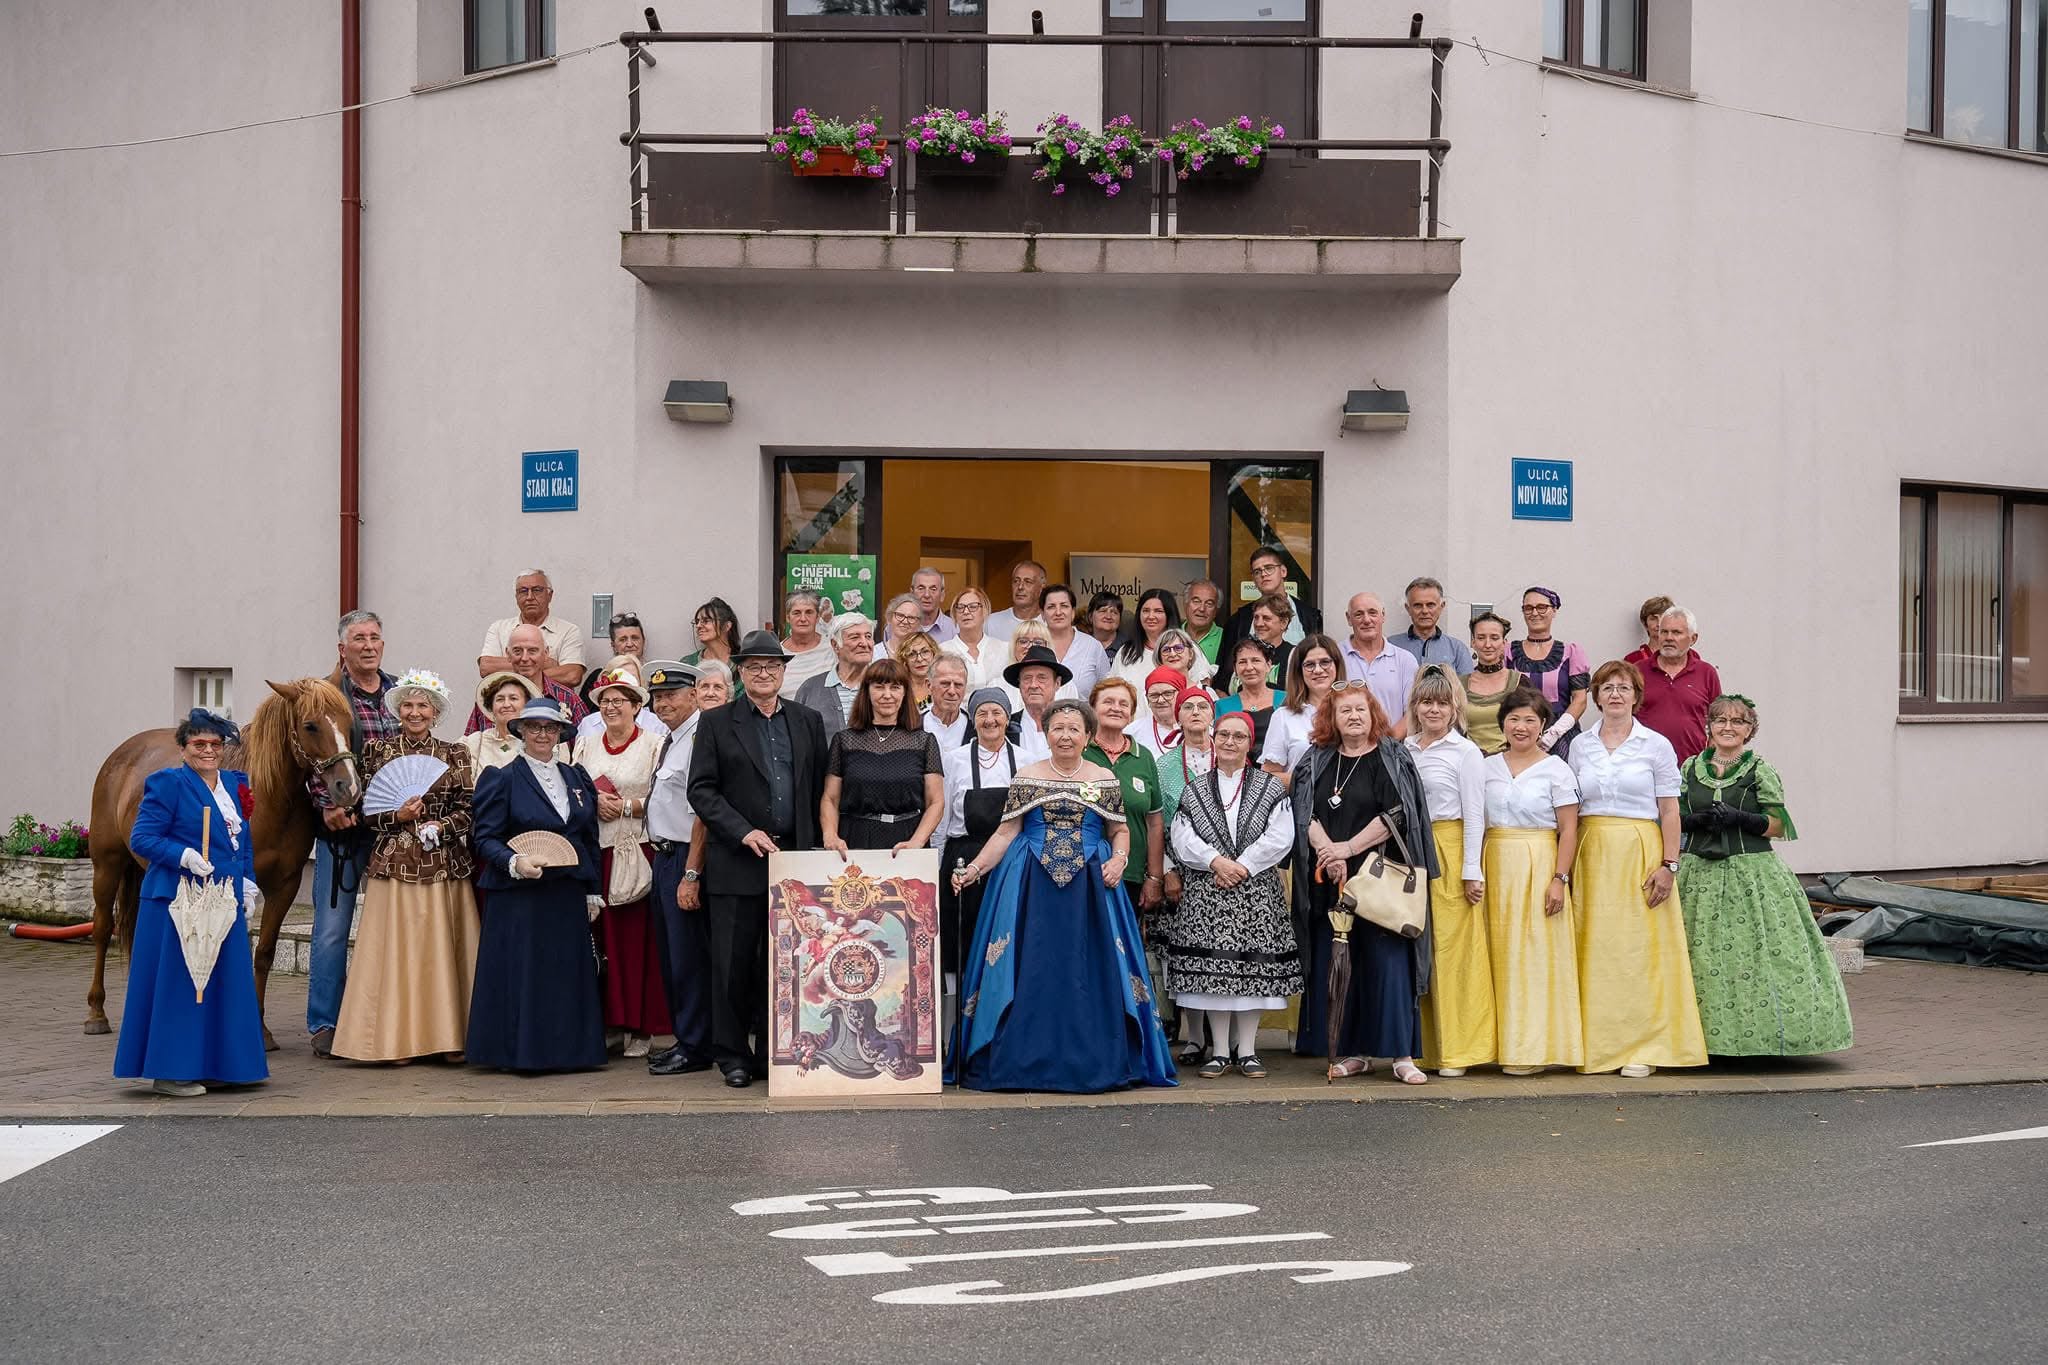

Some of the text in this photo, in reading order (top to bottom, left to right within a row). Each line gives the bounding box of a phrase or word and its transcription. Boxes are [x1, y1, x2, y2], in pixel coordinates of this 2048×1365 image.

[535, 461, 564, 472] ULICA
[1527, 468, 1559, 481] ULICA
[526, 477, 574, 498] STARI KRAJ
[1517, 484, 1568, 506] NOVI VAROŠ
[791, 567, 852, 578] CINEHILL
[801, 577, 824, 585] FILM
[1080, 575, 1142, 602] Mrkopalj
